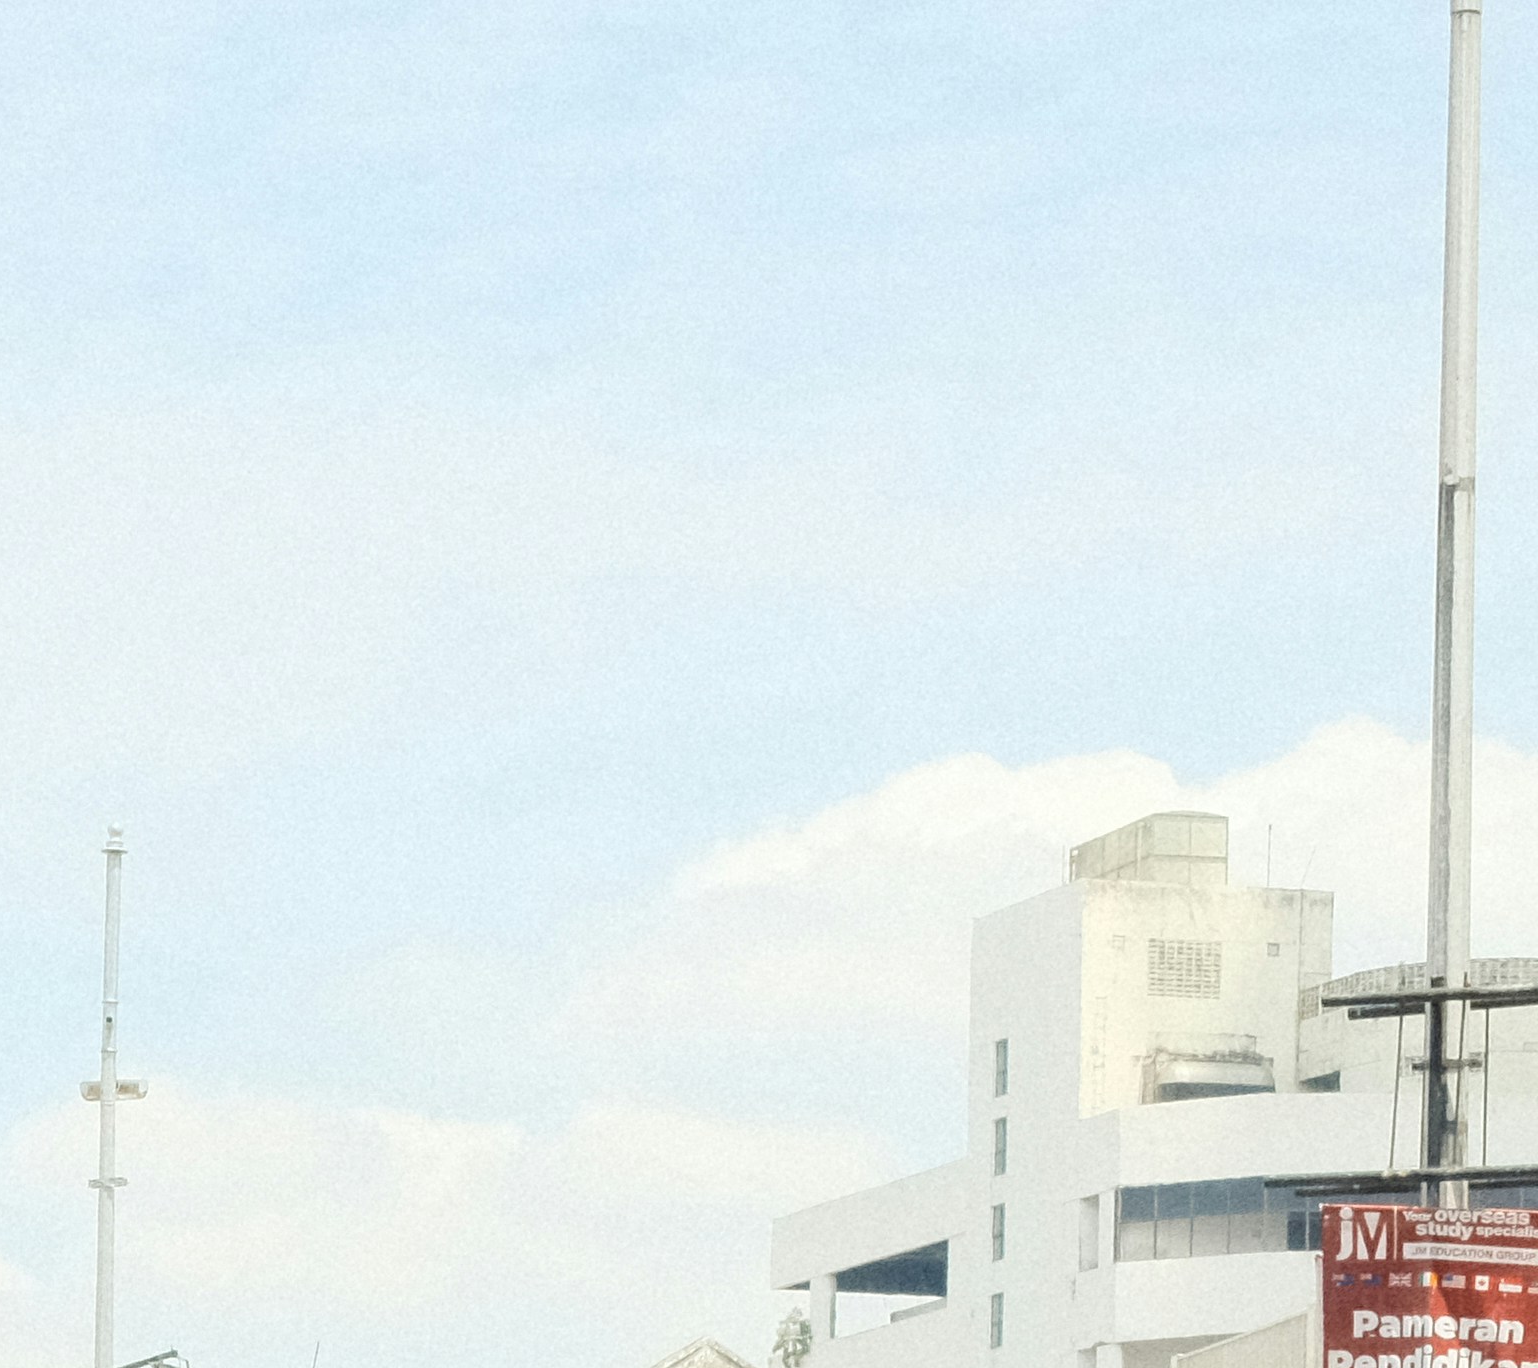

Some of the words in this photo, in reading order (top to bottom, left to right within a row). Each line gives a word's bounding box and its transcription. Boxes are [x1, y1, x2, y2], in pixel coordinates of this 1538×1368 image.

[1434, 1208, 1531, 1225] overseas
[1416, 1222, 1473, 1240] study
[1428, 1247, 1494, 1260] EDUCATION
[1496, 1251, 1537, 1262] GROUP
[1353, 1310, 1524, 1345] Pameran
